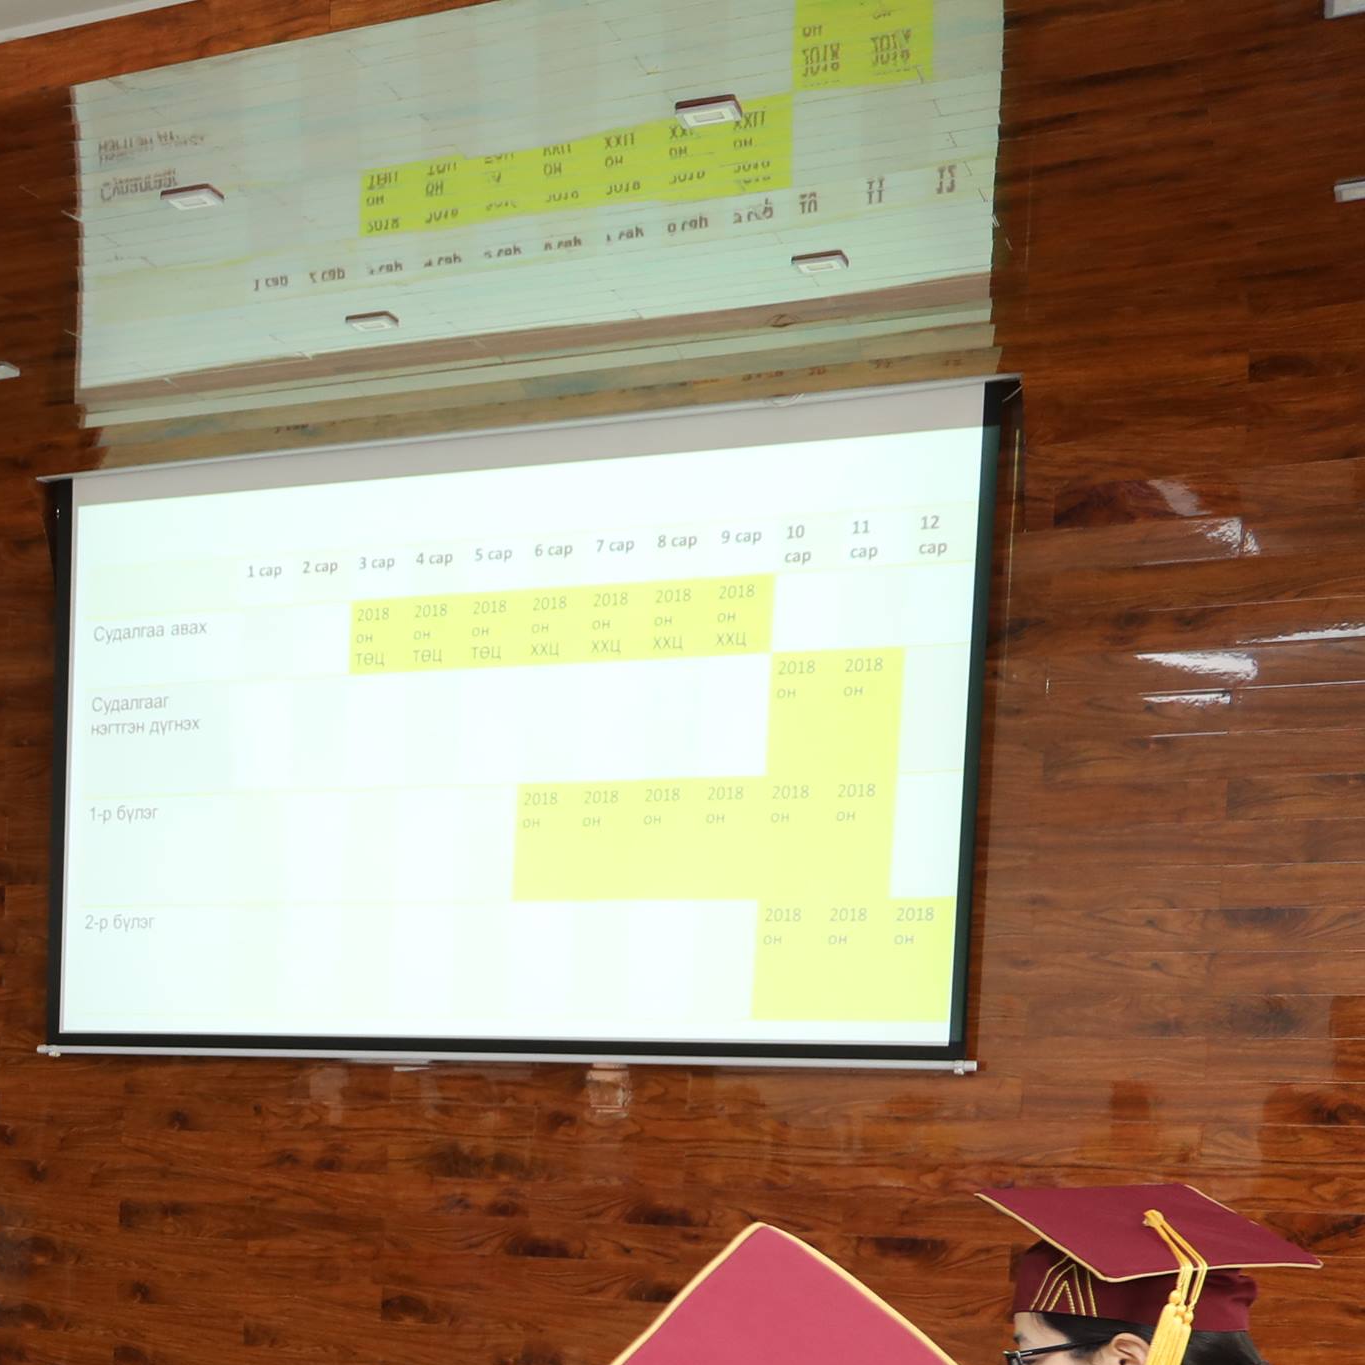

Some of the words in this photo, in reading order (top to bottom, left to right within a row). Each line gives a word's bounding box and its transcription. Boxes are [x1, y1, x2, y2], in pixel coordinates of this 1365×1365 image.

[852, 519, 870, 535] 11
[920, 514, 940, 531] 12
[721, 529, 731, 545] 9
[734, 531, 762, 545] сар
[786, 524, 806, 540] 10
[596, 538, 605, 553] 7
[608, 540, 635, 554] сар
[657, 534, 667, 549] 8
[671, 535, 698, 550] сар
[918, 542, 948, 557] сар
[474, 547, 484, 562] 5
[487, 548, 513, 563] сар
[534, 543, 544, 558] 6
[547, 544, 574, 559] сар
[784, 551, 812, 565] сар
[849, 546, 879, 561] сар
[359, 556, 367, 570] 3
[371, 557, 396, 571] сар
[415, 552, 425, 565] 4
[428, 553, 454, 567] сар
[247, 565, 255, 578] 1
[258, 566, 283, 579] сар
[302, 560, 310, 575] 2
[314, 561, 338, 576] сар
[593, 591, 629, 608] 2018
[655, 588, 692, 604] 2018
[718, 583, 756, 600] 2018
[414, 602, 448, 619] 2018
[472, 599, 507, 616] 2018
[532, 595, 568, 612] 2018
[357, 607, 390, 623] 2018
[93, 625, 165, 644] Судалгаа
[170, 622, 207, 637] авах
[777, 659, 816, 676] 2018
[844, 656, 884, 673] 2018
[91, 695, 170, 716] Судалгааг
[90, 721, 145, 736] нэгтгэн
[583, 789, 619, 805] 2018
[644, 787, 681, 803] 2018
[707, 785, 744, 801] 2018
[772, 784, 810, 801] 2018
[837, 782, 876, 799] 2018
[524, 791, 558, 807] 2018
[764, 907, 802, 923] 2018
[829, 907, 868, 923] 2018
[896, 906, 935, 922] 2018
